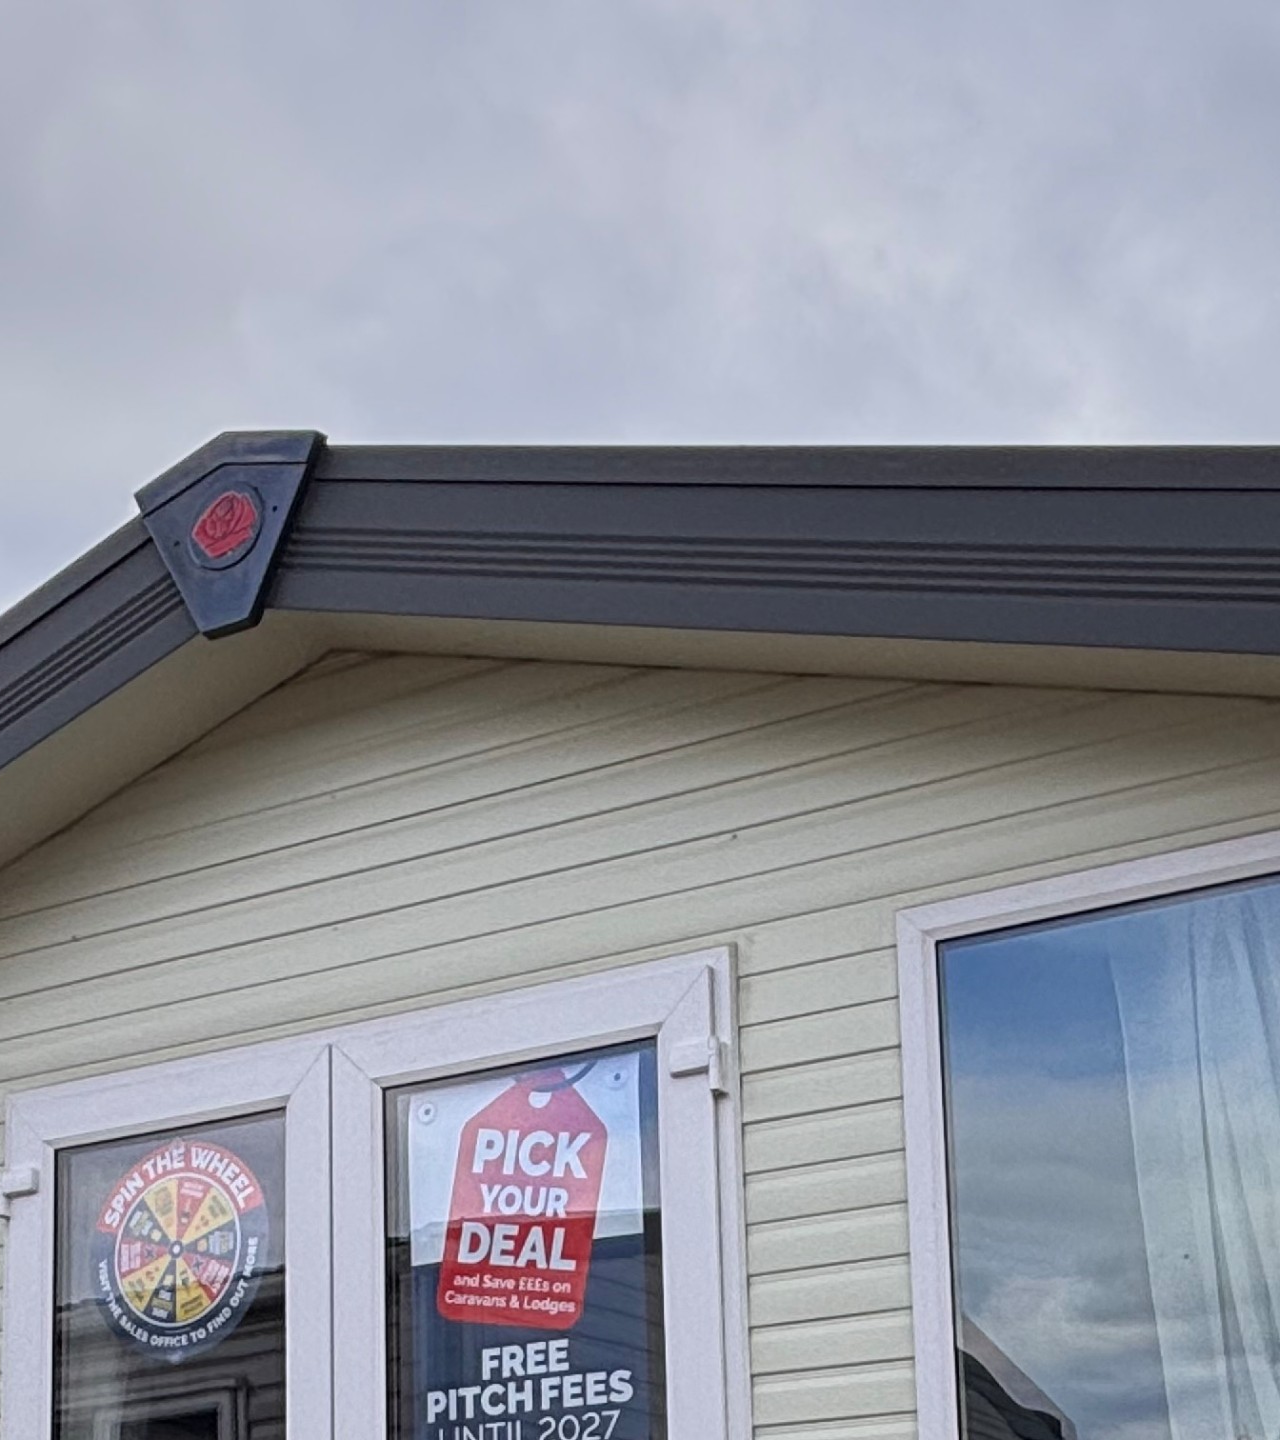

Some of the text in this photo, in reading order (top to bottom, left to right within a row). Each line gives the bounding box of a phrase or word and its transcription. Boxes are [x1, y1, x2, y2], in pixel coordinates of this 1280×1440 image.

[472, 1128, 592, 1179] PICK
[104, 1172, 145, 1228] SPIN
[145, 1147, 185, 1180] THE
[191, 1146, 256, 1209] WHEEL
[480, 1183, 569, 1219] YOUR
[457, 1221, 577, 1271] DEAL
[98, 1258, 111, 1293] VISIT
[119, 1314, 149, 1343] SALES
[149, 1332, 189, 1348] OFFICE
[189, 1327, 207, 1343] TO
[207, 1306, 233, 1334] FIND
[231, 1278, 251, 1309] OUT
[243, 1236, 259, 1278] MORE
[444, 1290, 576, 1315] Caravans & Lodges
[453, 1274, 480, 1289] and
[482, 1274, 516, 1291] Save
[552, 1280, 572, 1293] on
[482, 1338, 570, 1381] FREE
[426, 1369, 634, 1424] PITCH FEES
